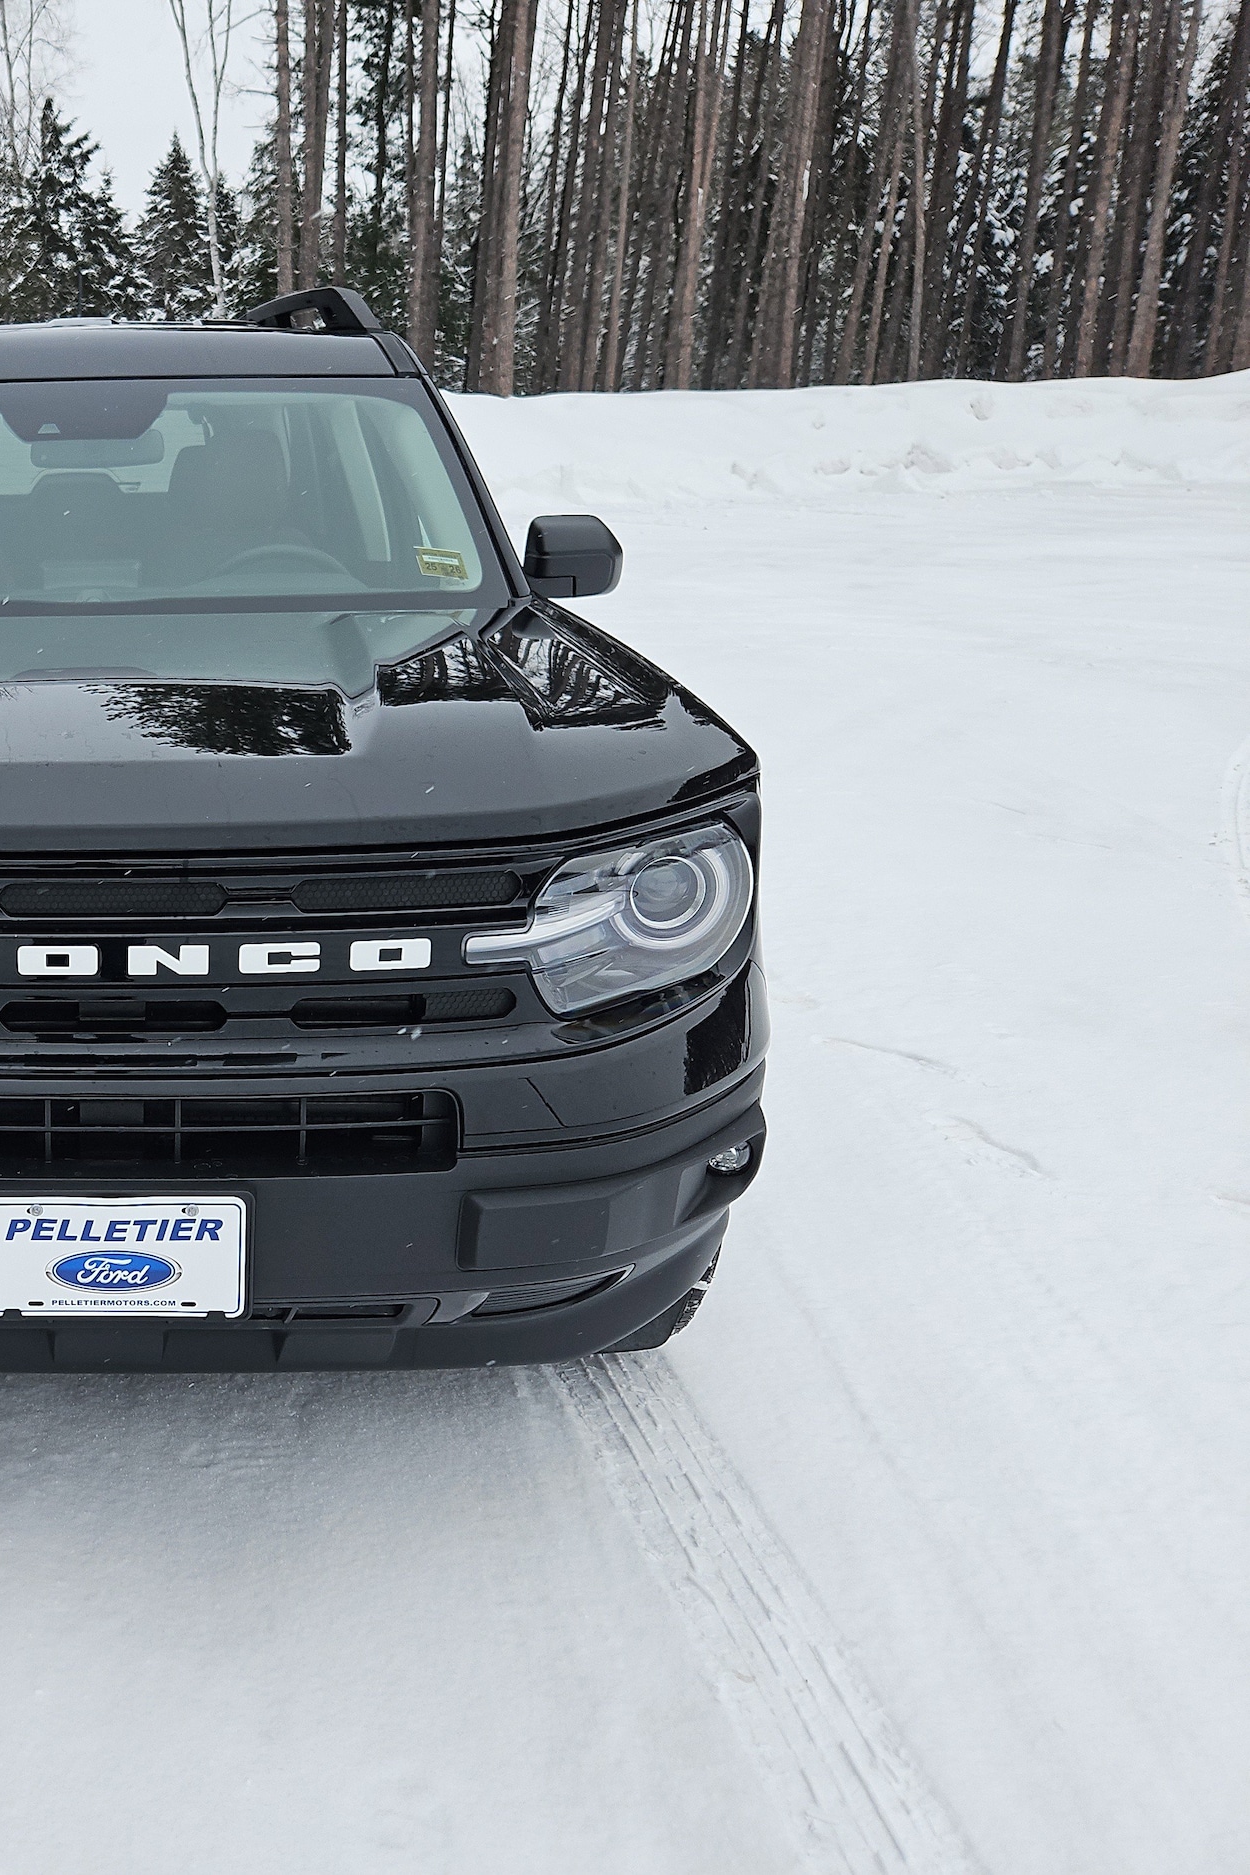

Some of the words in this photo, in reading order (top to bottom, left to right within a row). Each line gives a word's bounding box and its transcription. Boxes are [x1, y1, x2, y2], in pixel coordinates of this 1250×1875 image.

[5, 1218, 224, 1242] PELLETIER
[76, 1257, 149, 1285] Ford
[51, 1299, 176, 1307] PELLETIERMOTORS.COM
